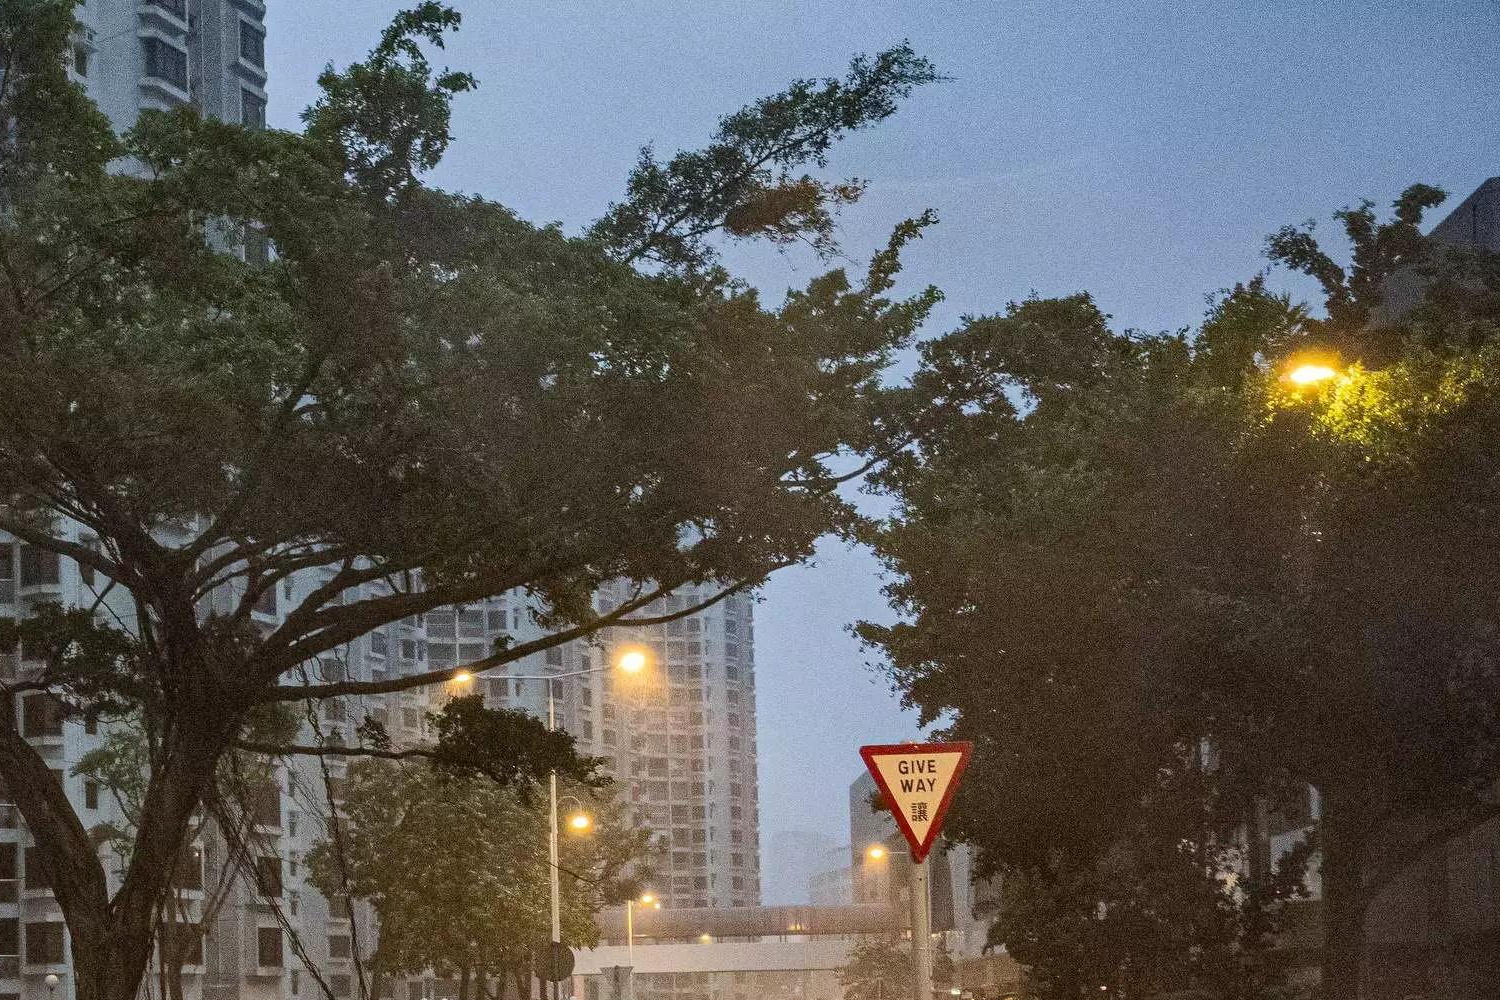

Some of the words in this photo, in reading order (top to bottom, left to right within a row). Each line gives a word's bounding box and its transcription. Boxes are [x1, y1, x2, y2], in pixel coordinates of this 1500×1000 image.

[898, 760, 937, 775] GIVE
[900, 778, 937, 793] WAY
[910, 801, 929, 821] 讓
